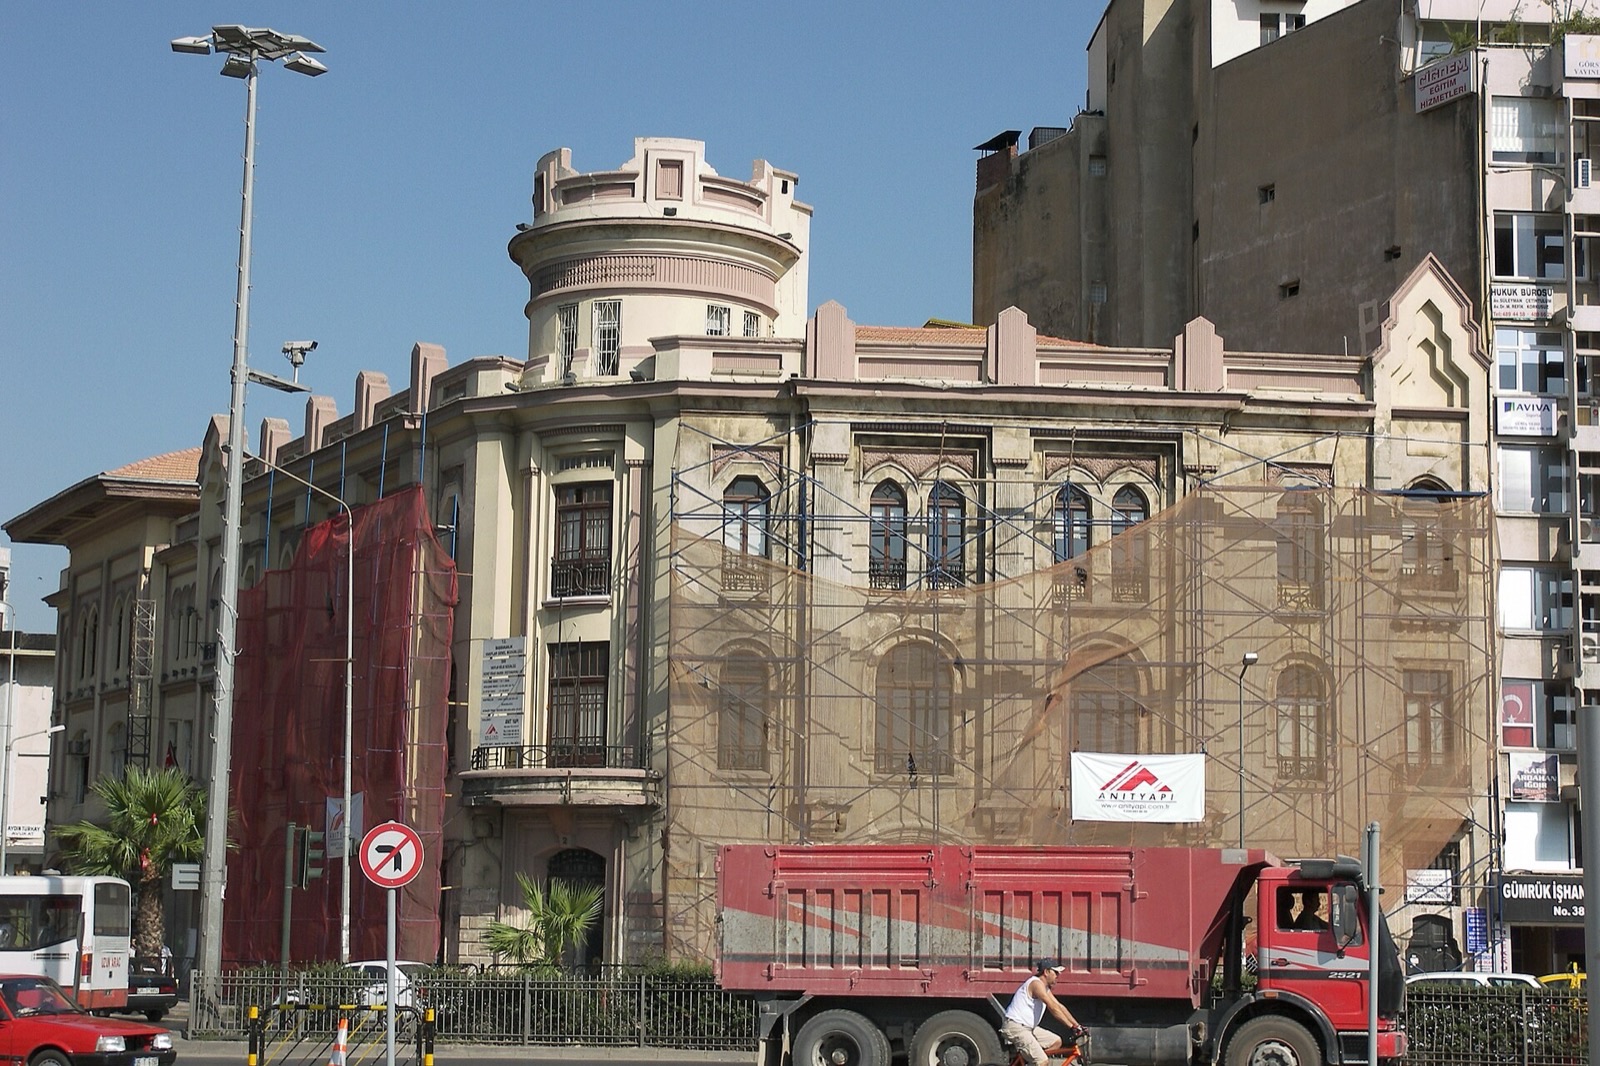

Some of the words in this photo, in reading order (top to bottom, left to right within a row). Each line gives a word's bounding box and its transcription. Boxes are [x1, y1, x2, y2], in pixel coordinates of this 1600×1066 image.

[1429, 78, 1457, 95] EĞİTİM
[1490, 288, 1518, 296] HUKUK
[1520, 287, 1553, 297] BÜROSU
[1516, 403, 1551, 412] AVIVA
[1098, 792, 1174, 801] ANITYAPI
[1502, 881, 1552, 899] GÜMRÜK
[1553, 905, 1571, 916] No.
[1571, 905, 1585, 916] 38
[1328, 971, 1362, 979] 2521
